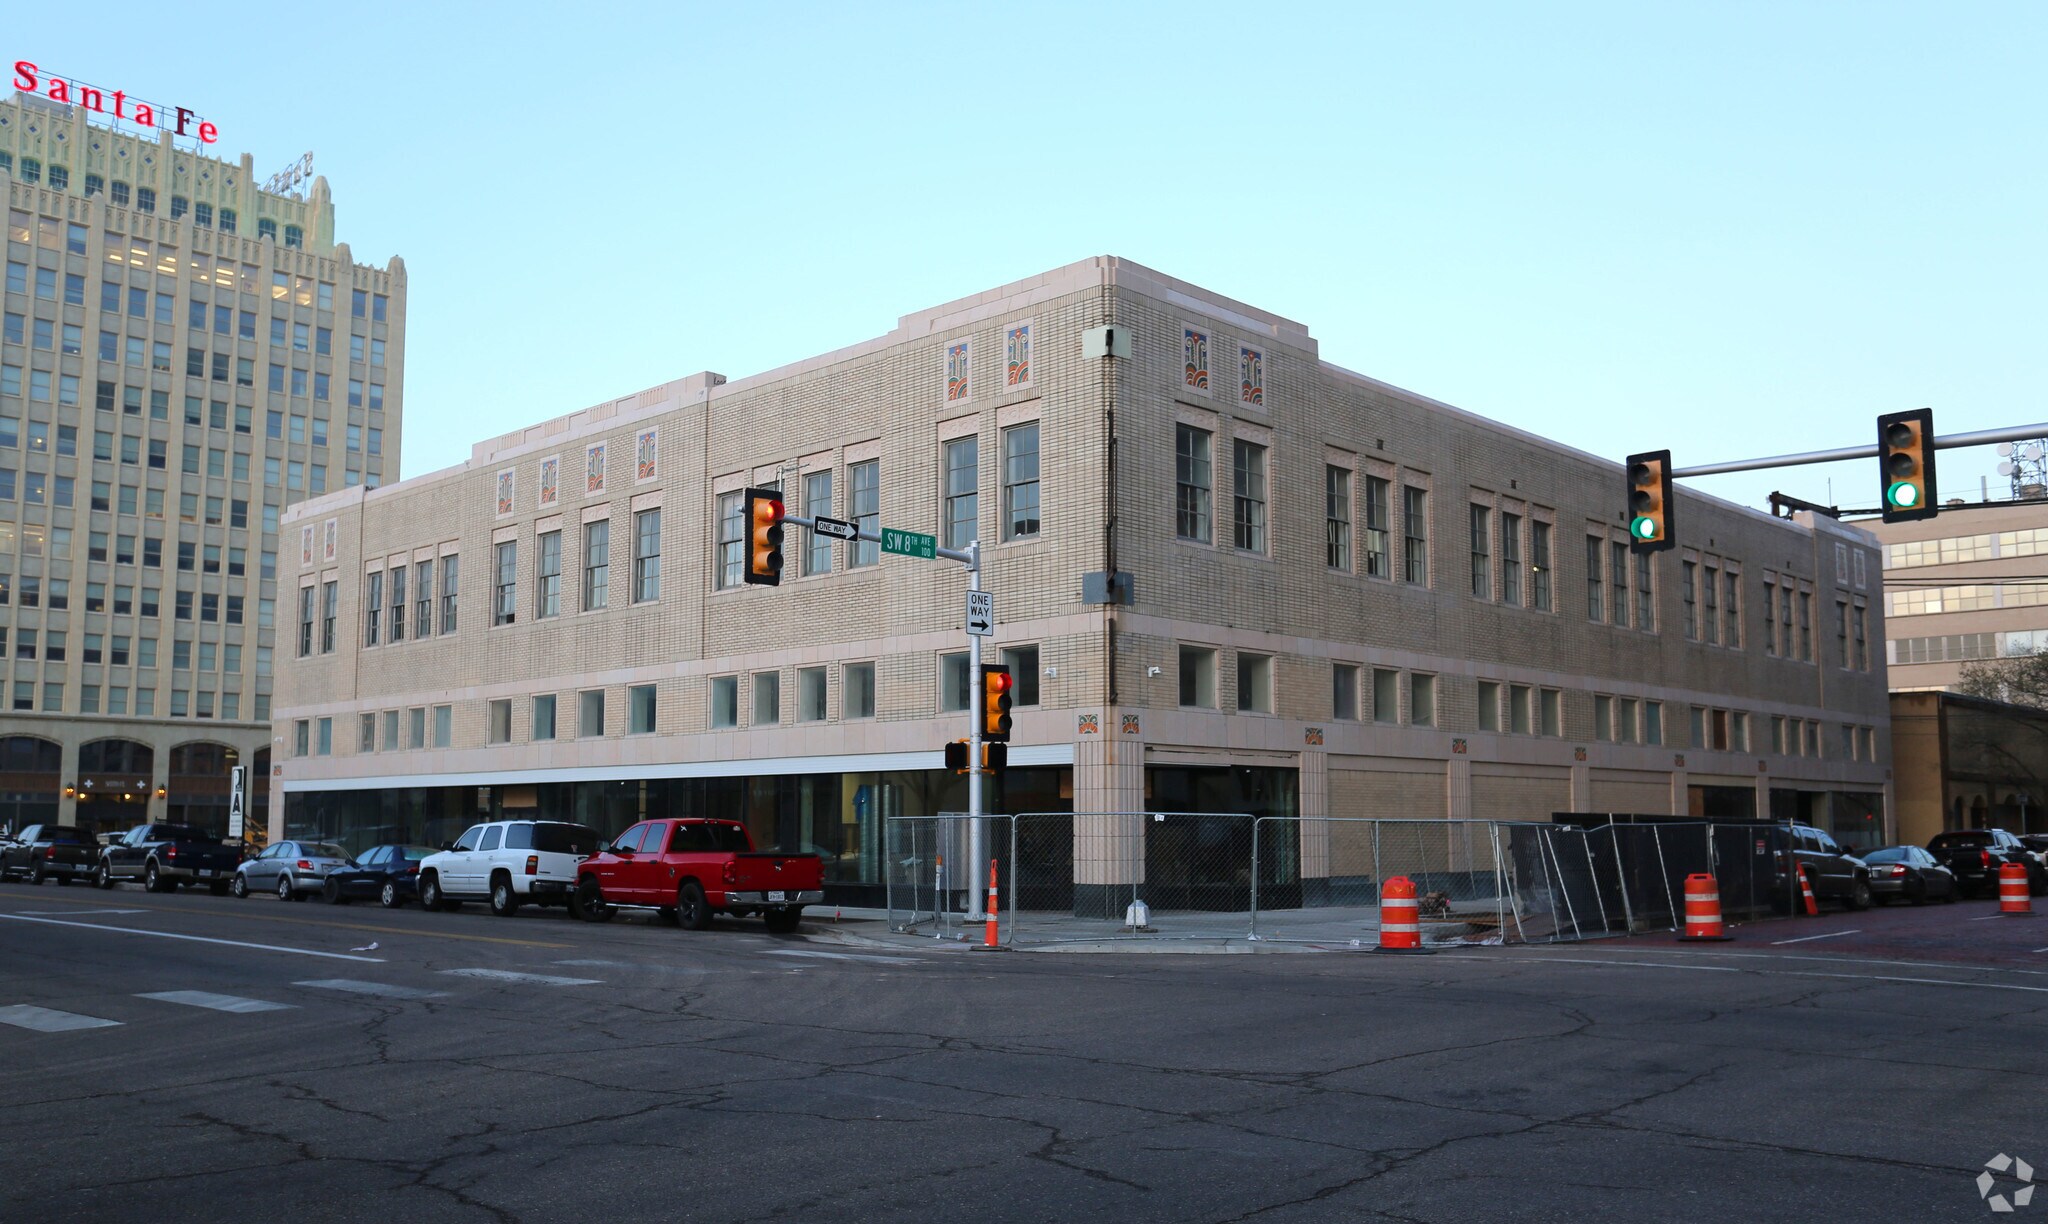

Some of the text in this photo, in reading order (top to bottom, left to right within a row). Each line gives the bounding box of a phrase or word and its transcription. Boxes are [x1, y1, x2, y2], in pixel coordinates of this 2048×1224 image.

[13, 60, 218, 144] Santa Fe
[818, 522, 846, 534] ONE WAY
[886, 532, 931, 552] SW 8TH AVE
[921, 546, 931, 557] 100
[971, 594, 989, 606] ONE
[970, 605, 990, 617] WAY
